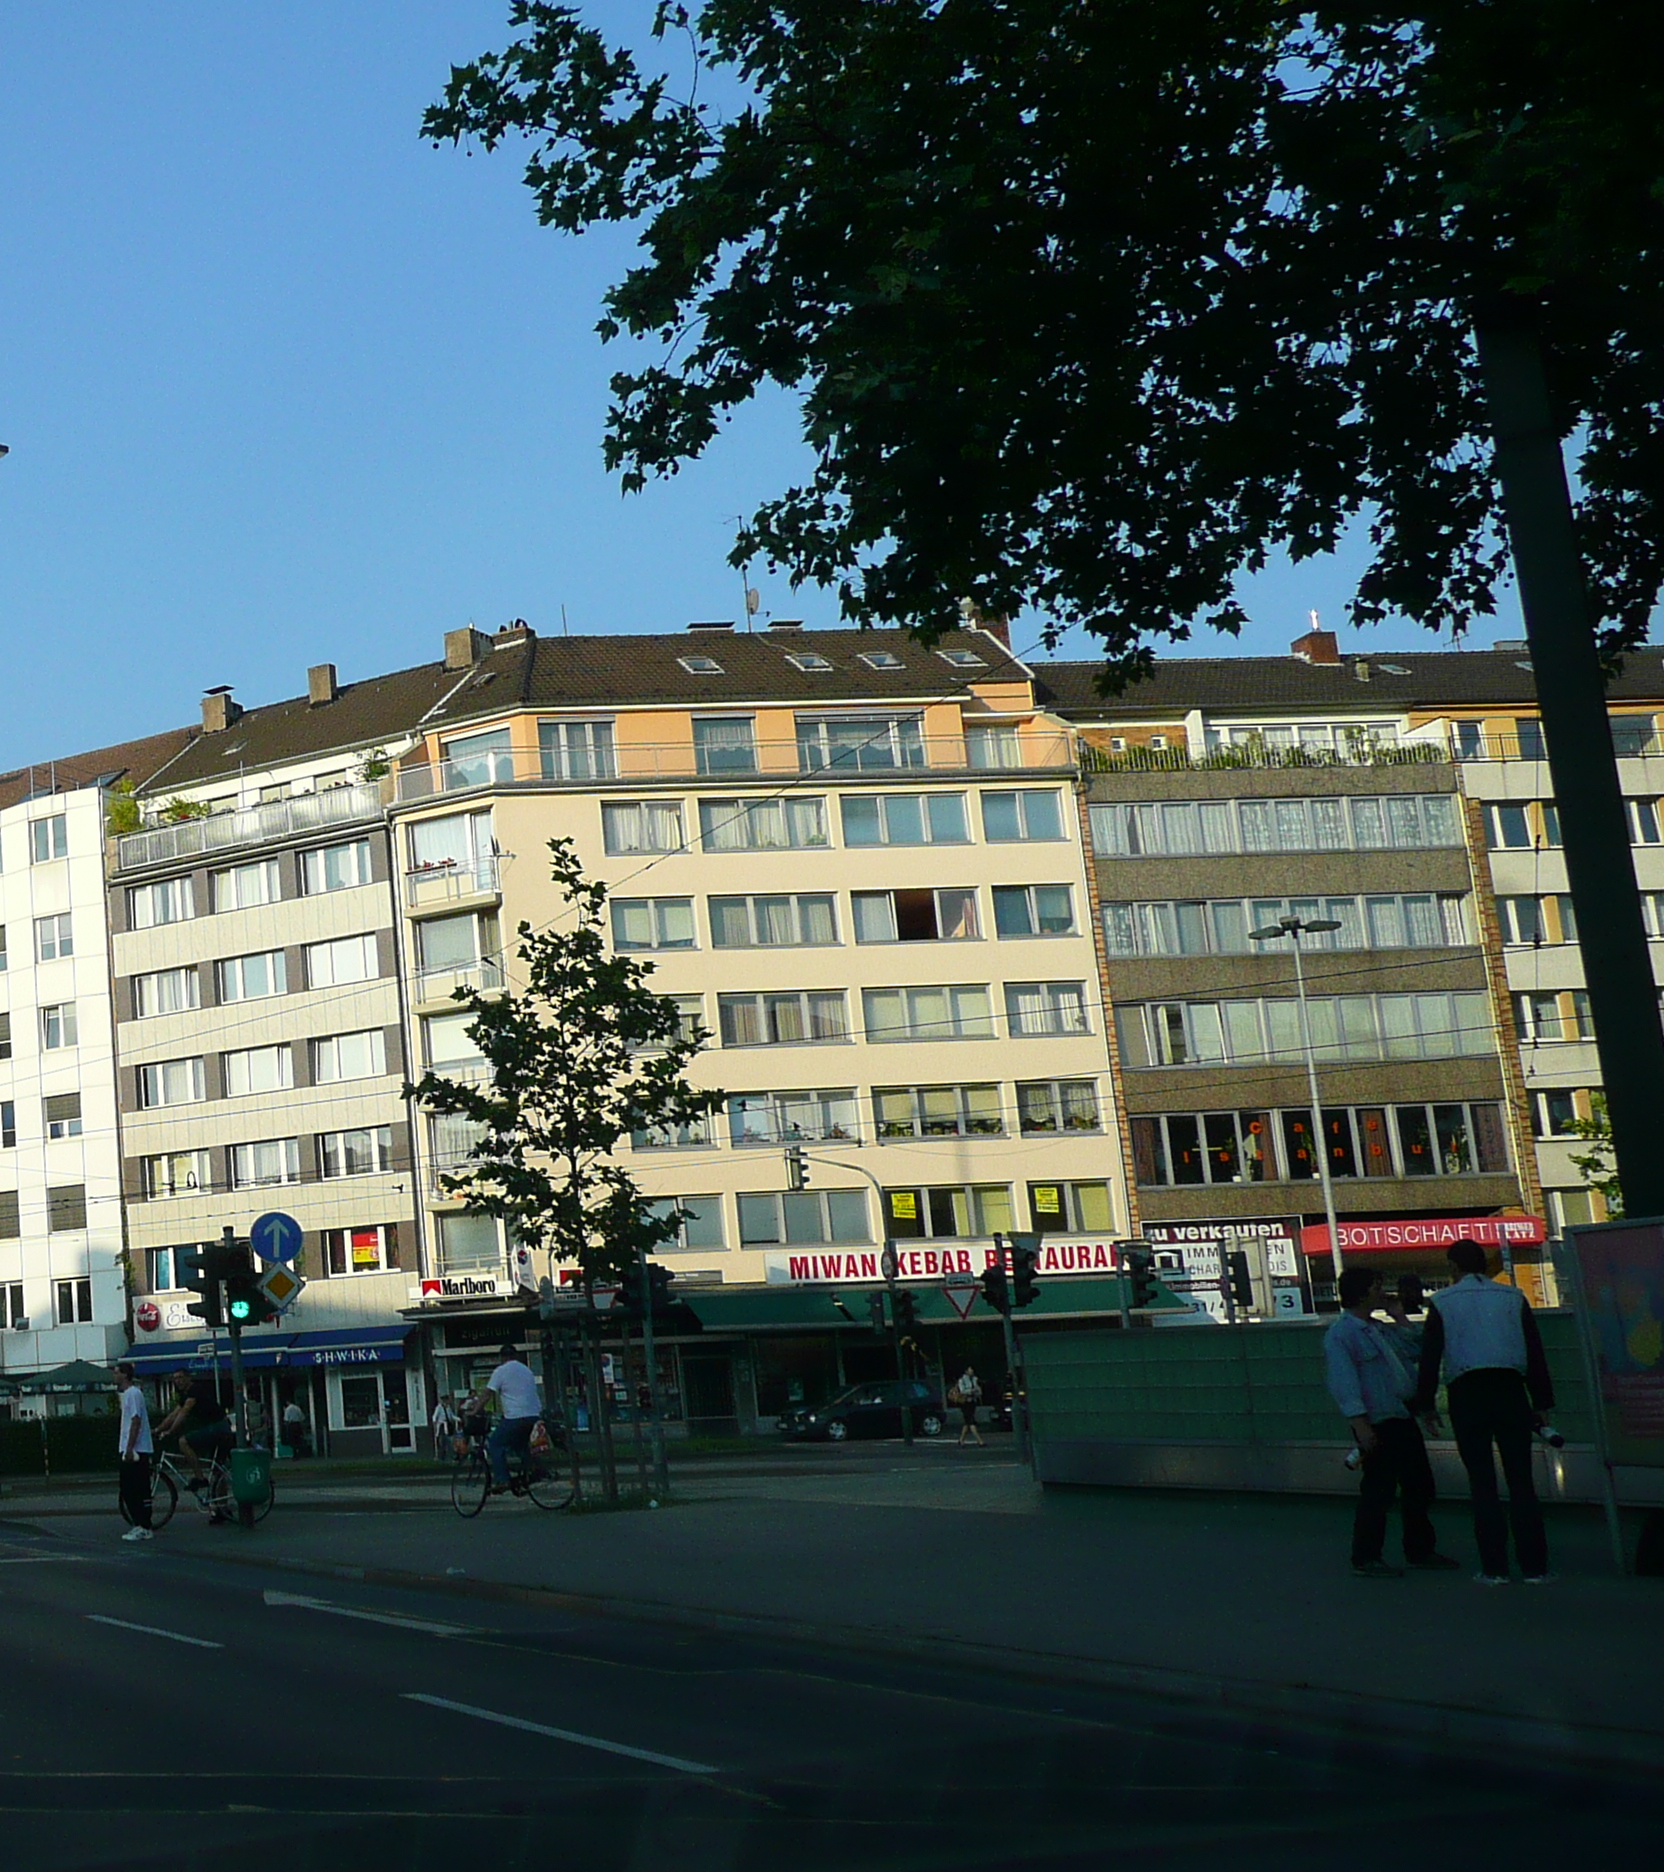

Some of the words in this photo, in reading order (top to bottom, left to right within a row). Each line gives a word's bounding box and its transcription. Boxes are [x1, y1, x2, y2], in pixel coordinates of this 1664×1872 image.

[1173, 1222, 1285, 1241] verkaufen
[1336, 1223, 1488, 1246] BOTSCHAFT
[789, 1254, 877, 1280] MIWAN
[895, 1249, 971, 1276] KEBAB
[441, 1277, 496, 1297] Marlboro
